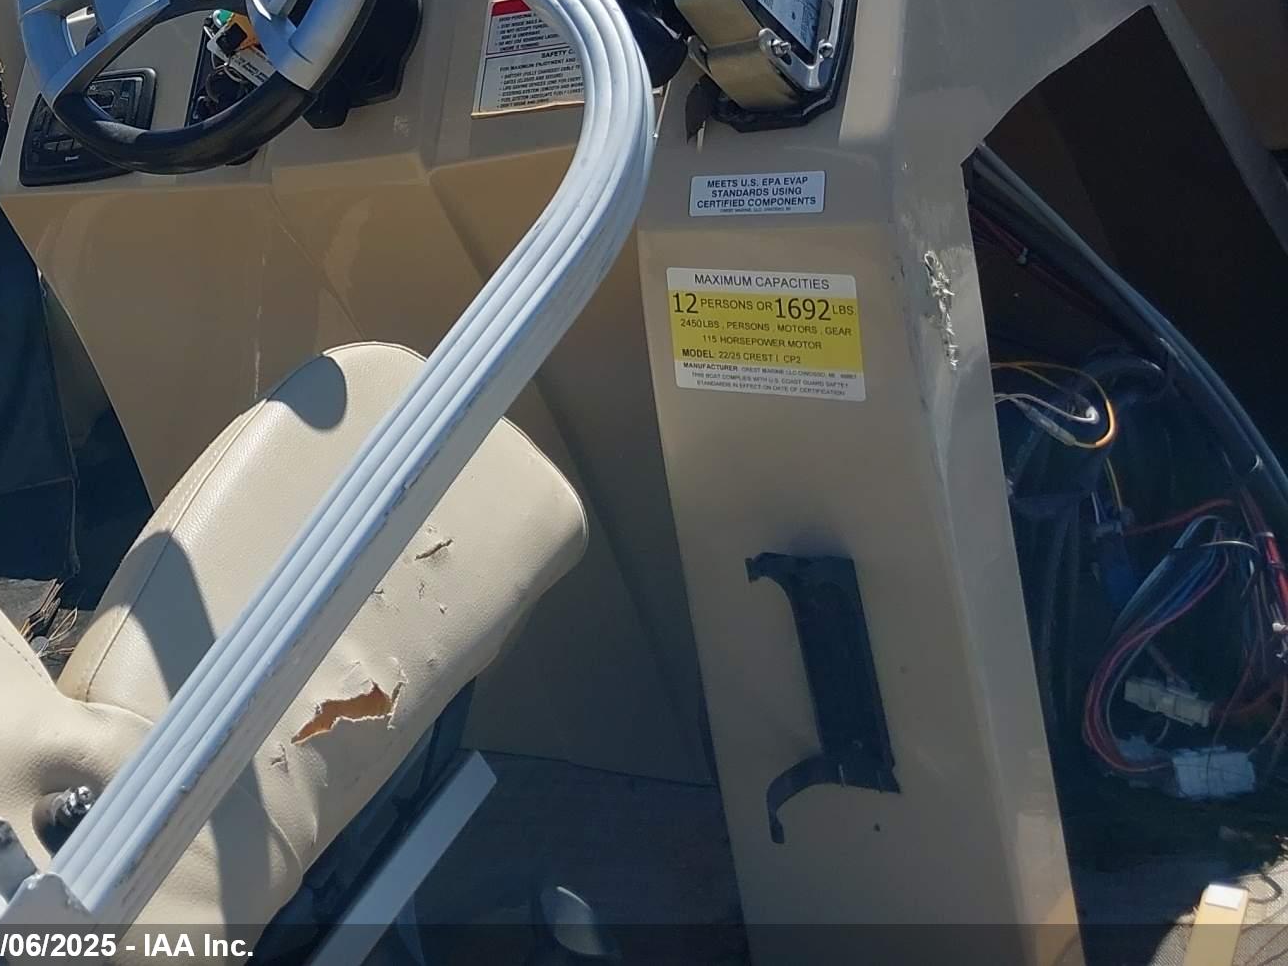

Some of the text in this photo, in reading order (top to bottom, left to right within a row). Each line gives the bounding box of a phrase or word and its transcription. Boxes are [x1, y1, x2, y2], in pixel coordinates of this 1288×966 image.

[707, 176, 808, 188] MEETS U.S. EPA EVAP
[711, 186, 802, 198] STANDARDS USING
[697, 196, 816, 209] CERTIFIED COMPONENTS
[694, 273, 830, 290] MAXIMUM CAPACITIES
[673, 292, 699, 314] 12
[700, 298, 753, 310] PERSONS
[756, 300, 773, 312] OR
[775, 297, 831, 321] 1692
[824, 326, 853, 337] GEAR
[703, 335, 822, 350] 115 HORSEPOWER MOTOR
[743, 352, 773, 363] CREST
[783, 354, 801, 364] CP2
